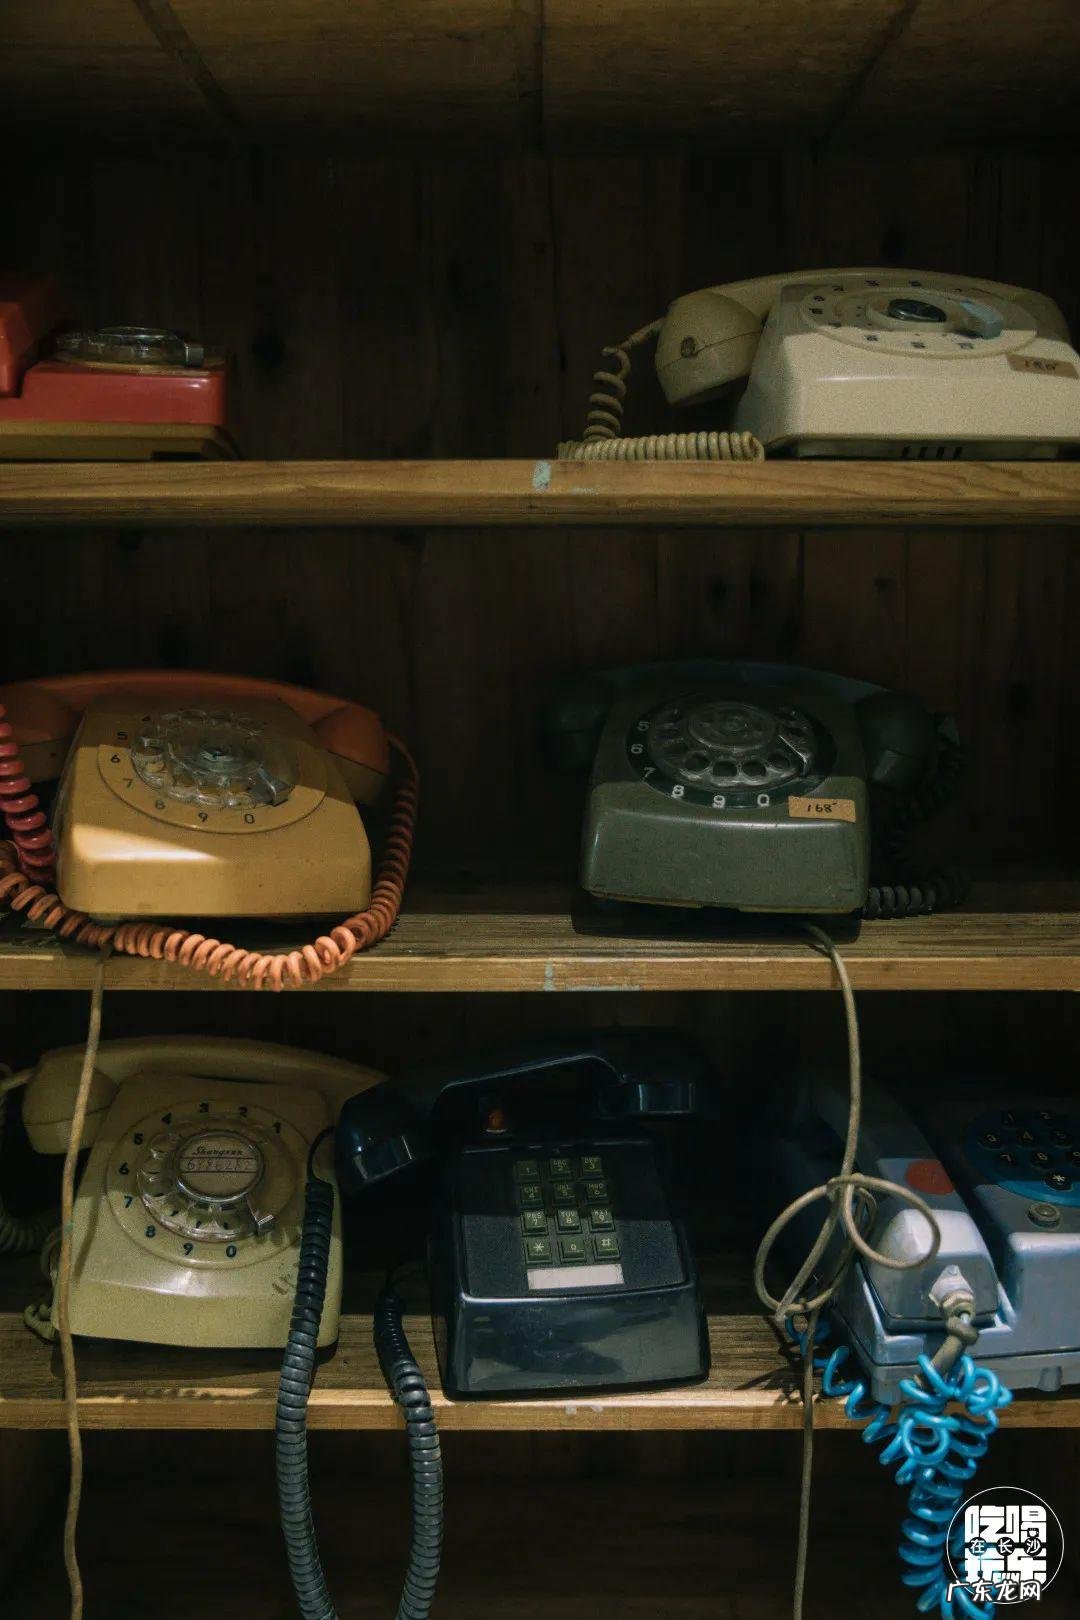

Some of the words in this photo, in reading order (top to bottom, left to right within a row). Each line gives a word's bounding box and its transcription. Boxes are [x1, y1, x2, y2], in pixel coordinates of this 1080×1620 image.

[637, 721, 650, 732] 5
[630, 743, 645, 755] 6
[644, 767, 657, 781] 7
[110, 754, 121, 764] 6
[123, 778, 134, 789] 7
[198, 812, 209, 823] 9
[244, 813, 255, 824] 0
[671, 784, 686, 799] 8
[712, 795, 726, 809] 9
[757, 793, 770, 808] 0
[199, 1102, 209, 1114] 3
[239, 1106, 248, 1118] 2
[162, 1113, 172, 1125] 4
[273, 1121, 282, 1134] 1
[134, 1133, 144, 1146] 5
[118, 1162, 130, 1175] 6
[123, 1195, 133, 1209] 7
[145, 1225, 156, 1239] 8
[183, 1242, 194, 1256] 9
[225, 1245, 237, 1258] 0
